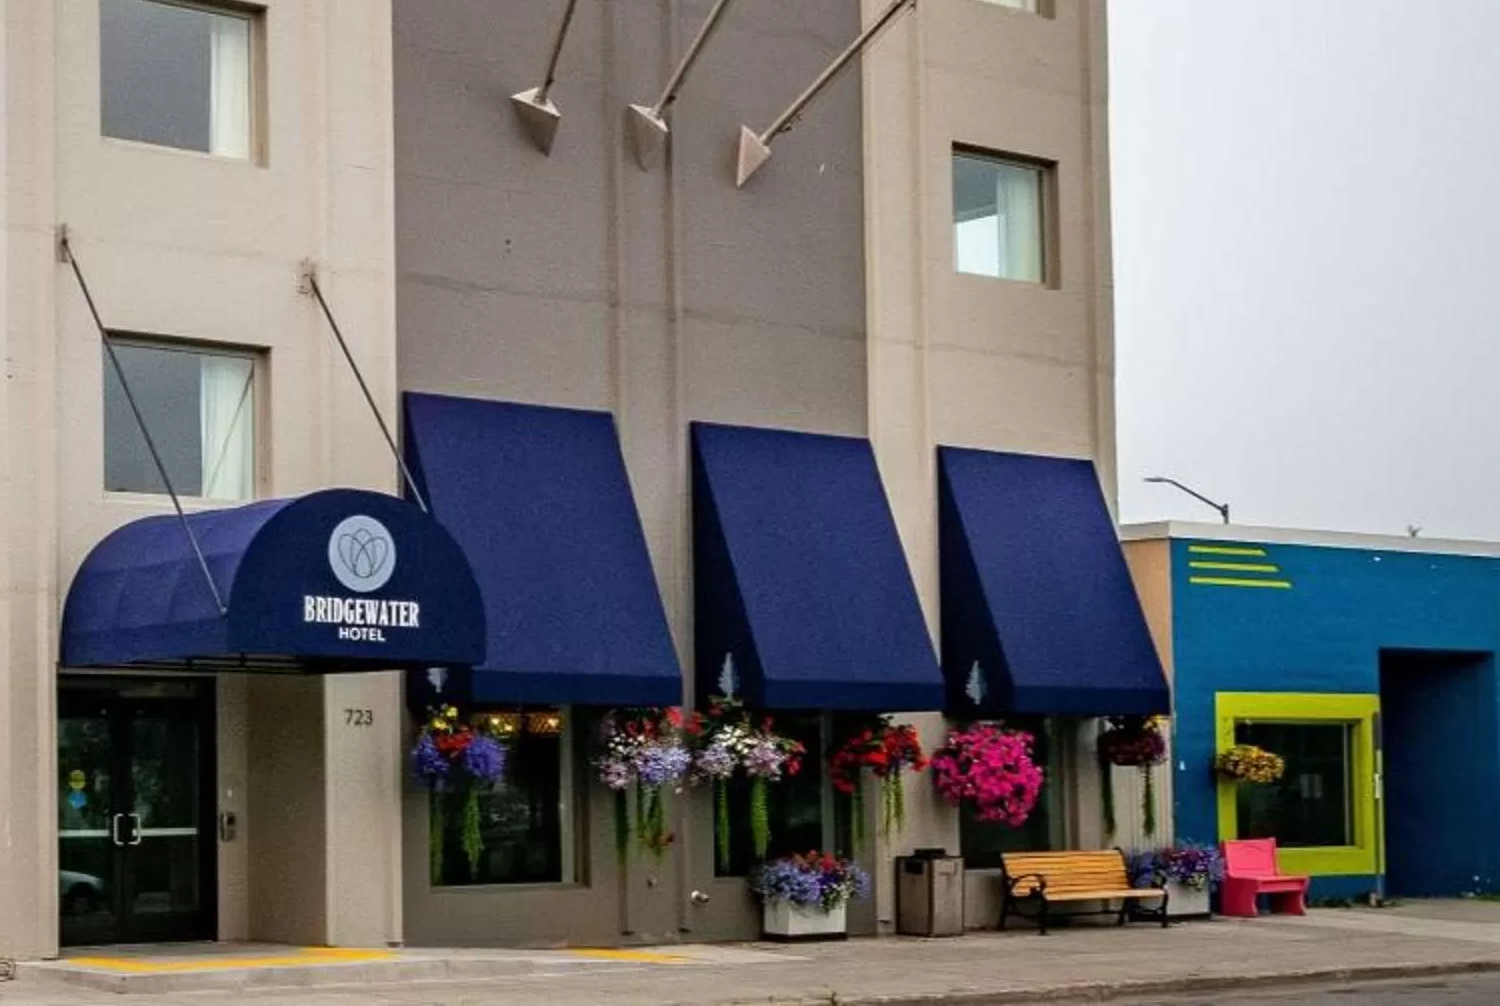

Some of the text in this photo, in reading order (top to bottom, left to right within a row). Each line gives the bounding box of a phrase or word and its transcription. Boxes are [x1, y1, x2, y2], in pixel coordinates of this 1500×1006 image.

[303, 595, 420, 628] BRIDGEWATER
[338, 626, 387, 642] HOTEL
[343, 709, 373, 726] 723
